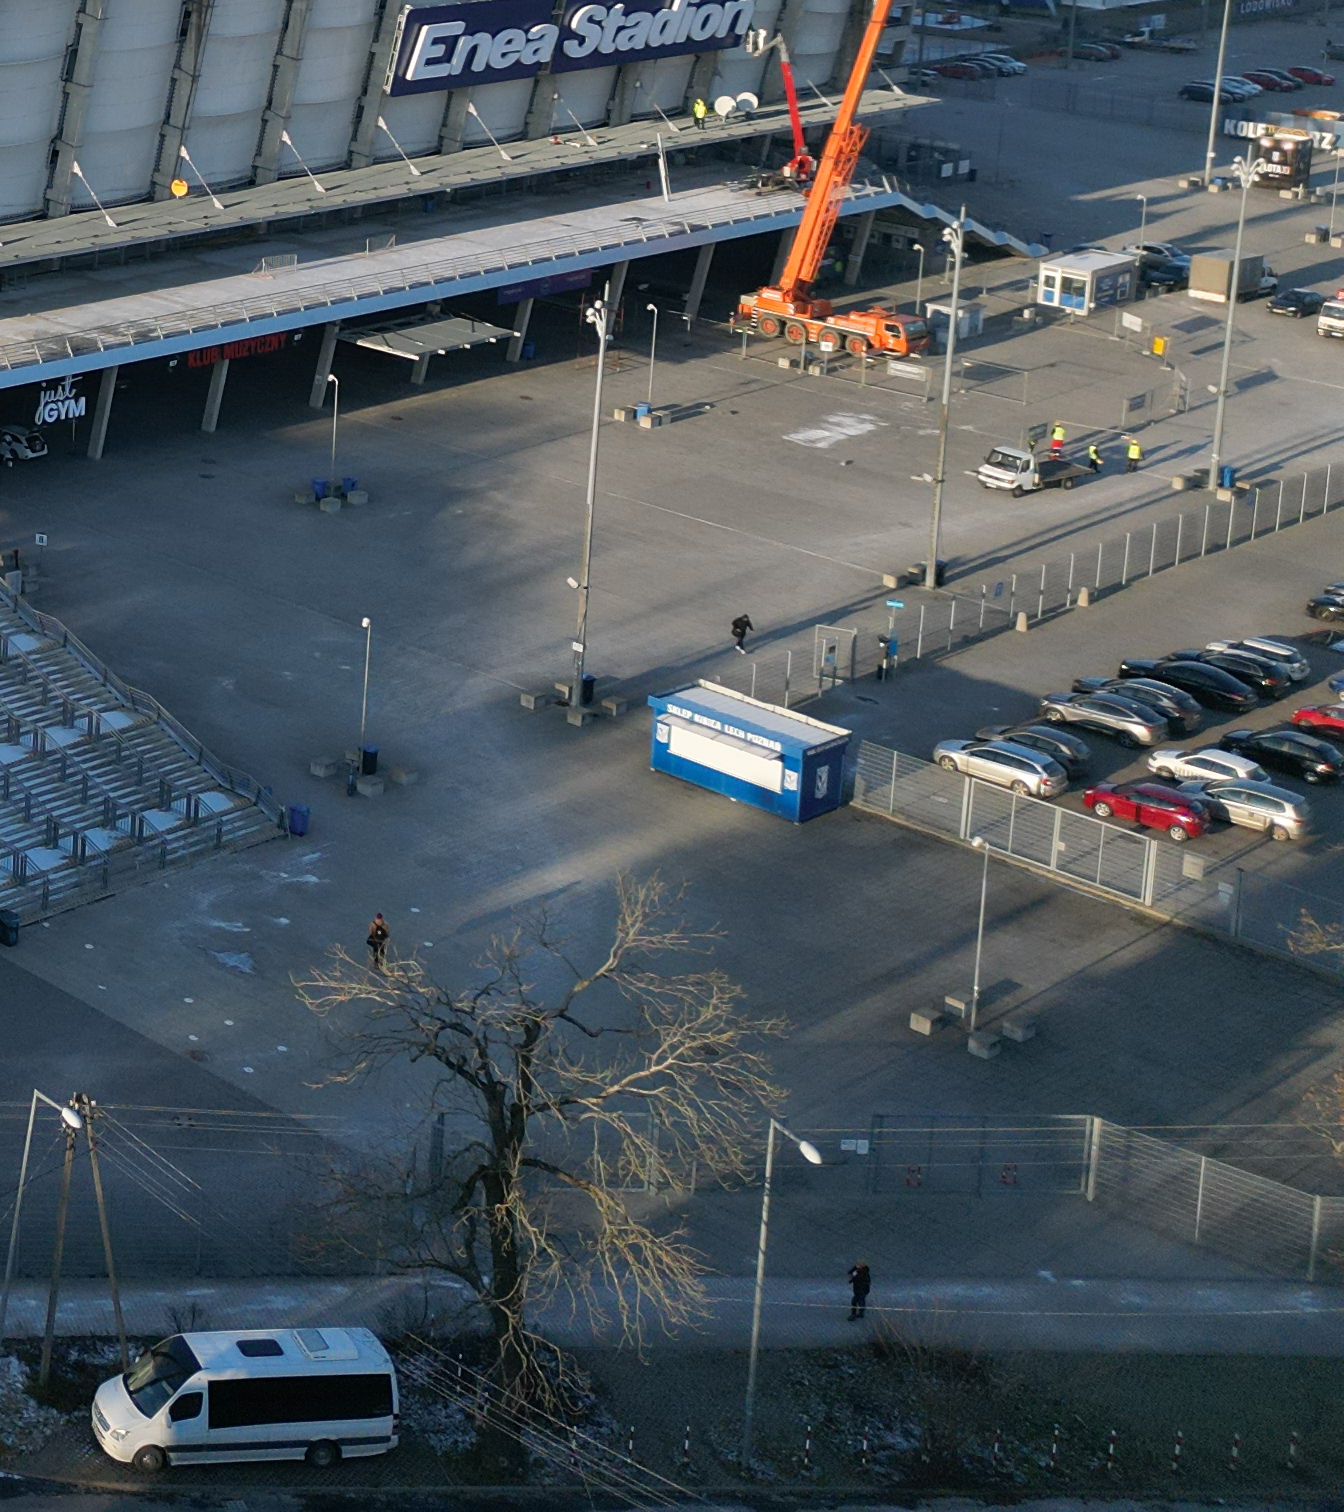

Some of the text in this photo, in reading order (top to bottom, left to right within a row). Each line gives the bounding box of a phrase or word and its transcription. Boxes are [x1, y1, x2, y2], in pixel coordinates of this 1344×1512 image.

[406, 21, 559, 81] Enea
[188, 333, 288, 368] KLUB MUZYCZNY
[35, 374, 83, 425] just
[44, 396, 86, 423] GYM
[724, 723, 745, 739] LECH
